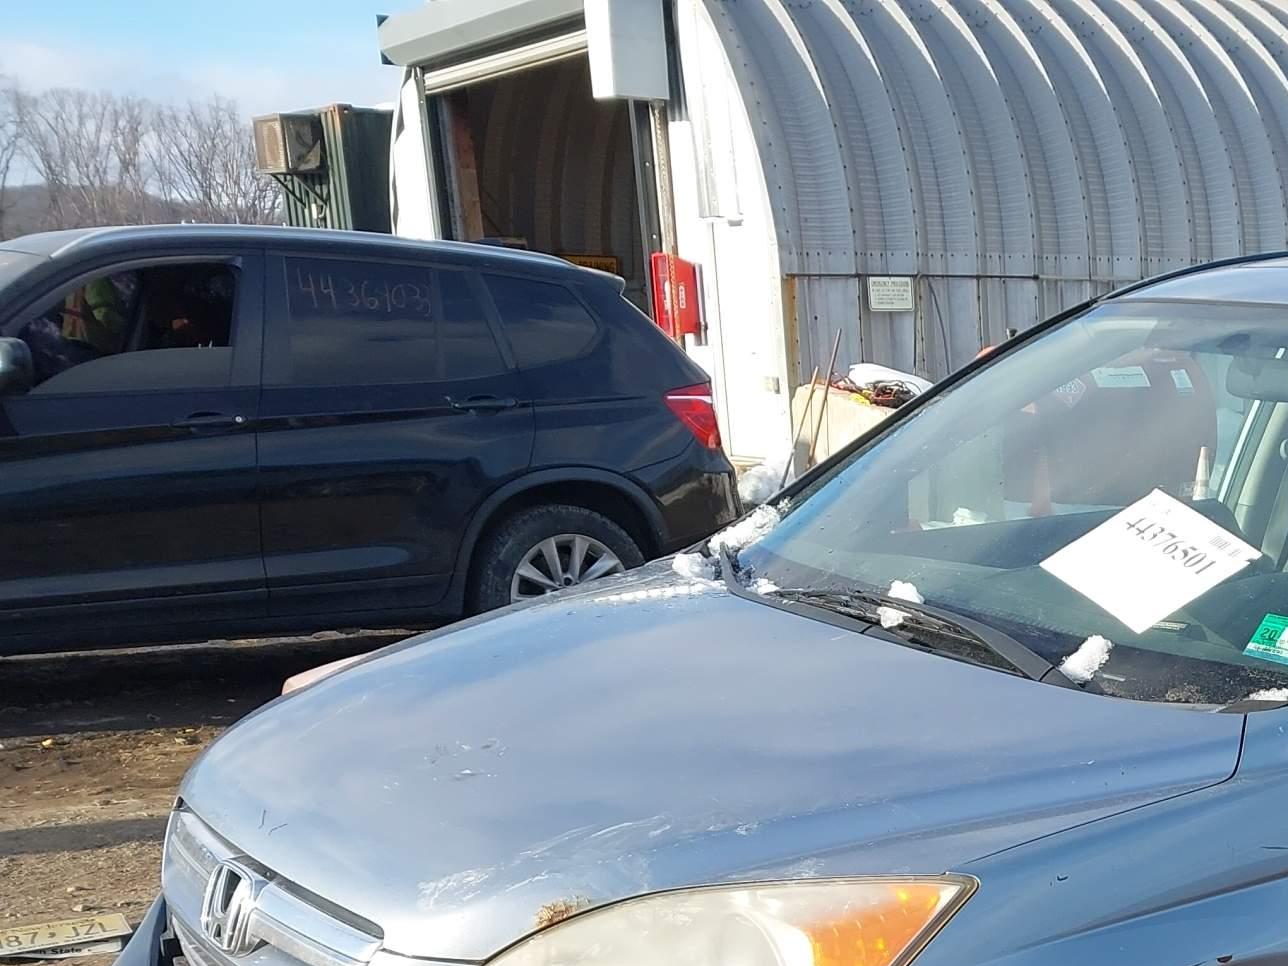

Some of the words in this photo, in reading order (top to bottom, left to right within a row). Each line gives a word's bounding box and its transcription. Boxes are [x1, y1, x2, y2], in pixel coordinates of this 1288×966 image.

[1126, 517, 1217, 575] 44376501
[1260, 627, 1279, 642] 20
[0, 931, 39, 949] 87
